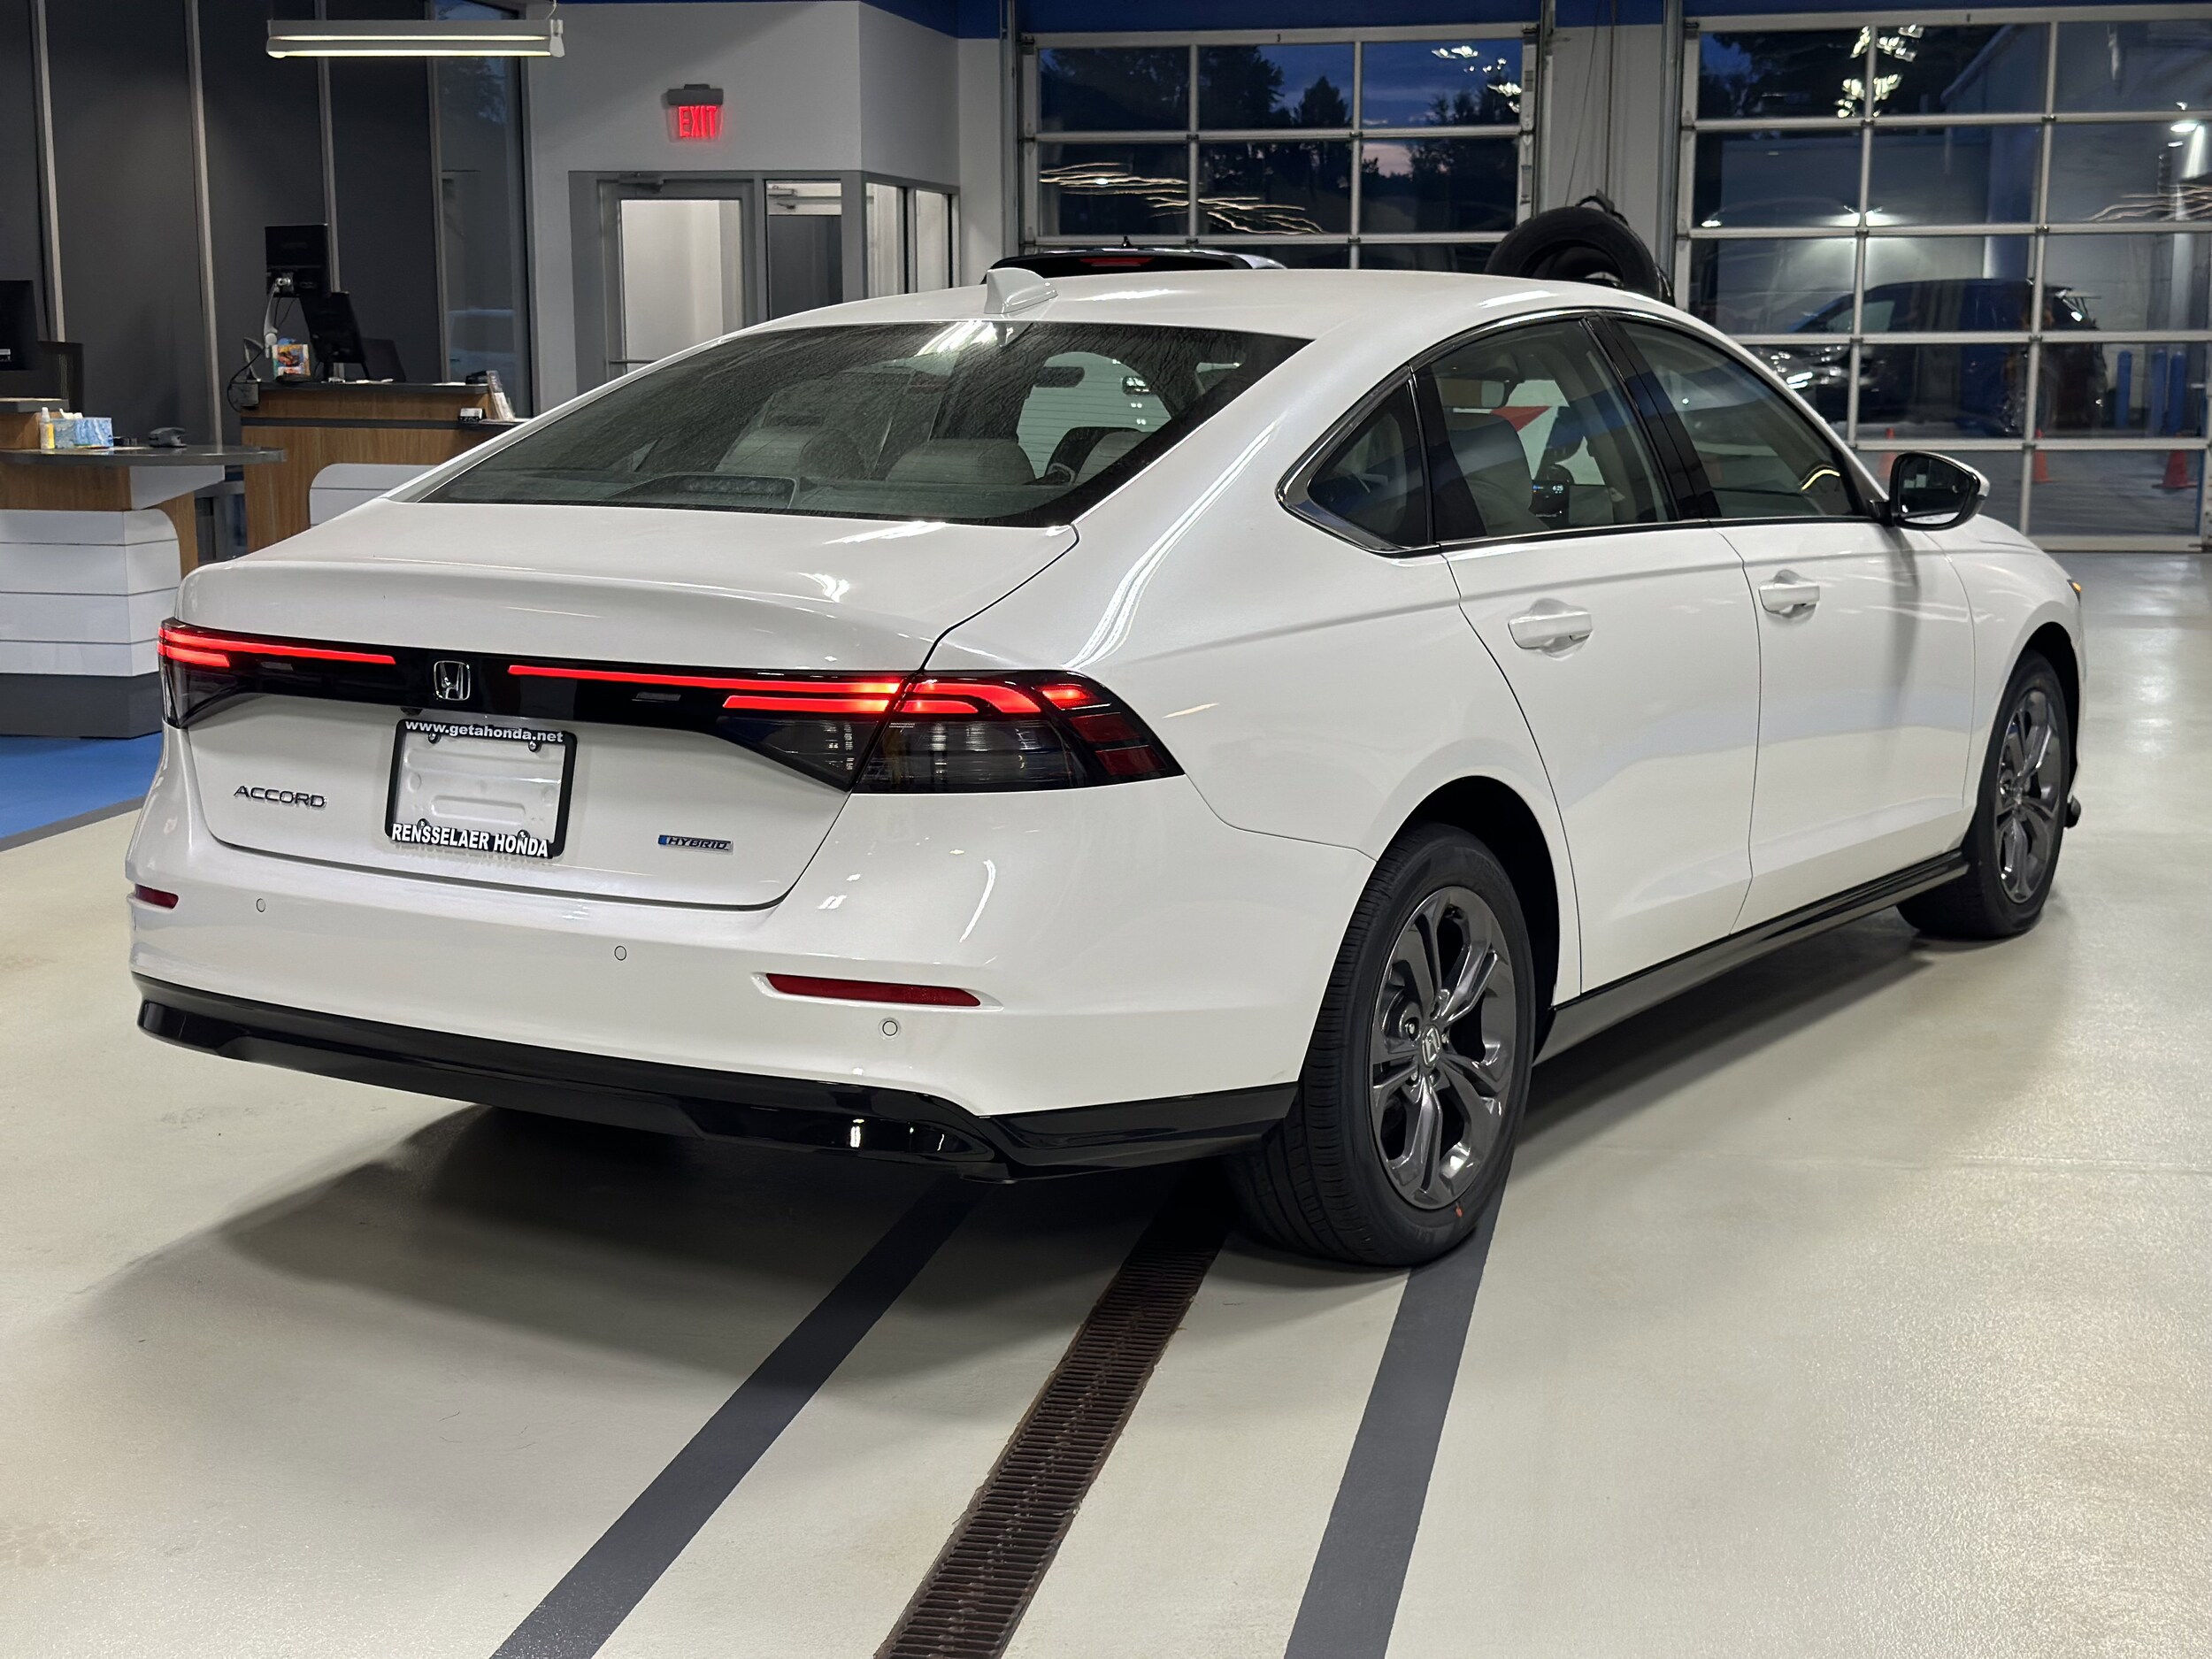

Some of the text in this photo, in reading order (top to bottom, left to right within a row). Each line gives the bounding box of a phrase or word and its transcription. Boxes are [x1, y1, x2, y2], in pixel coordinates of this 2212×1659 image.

[678, 105, 717, 138] EXIT
[404, 720, 564, 743] www.getahonda.net
[233, 786, 326, 808] ACCORD
[392, 823, 549, 858] RENSSELAER HONDA
[668, 836, 729, 851] HYBRID
